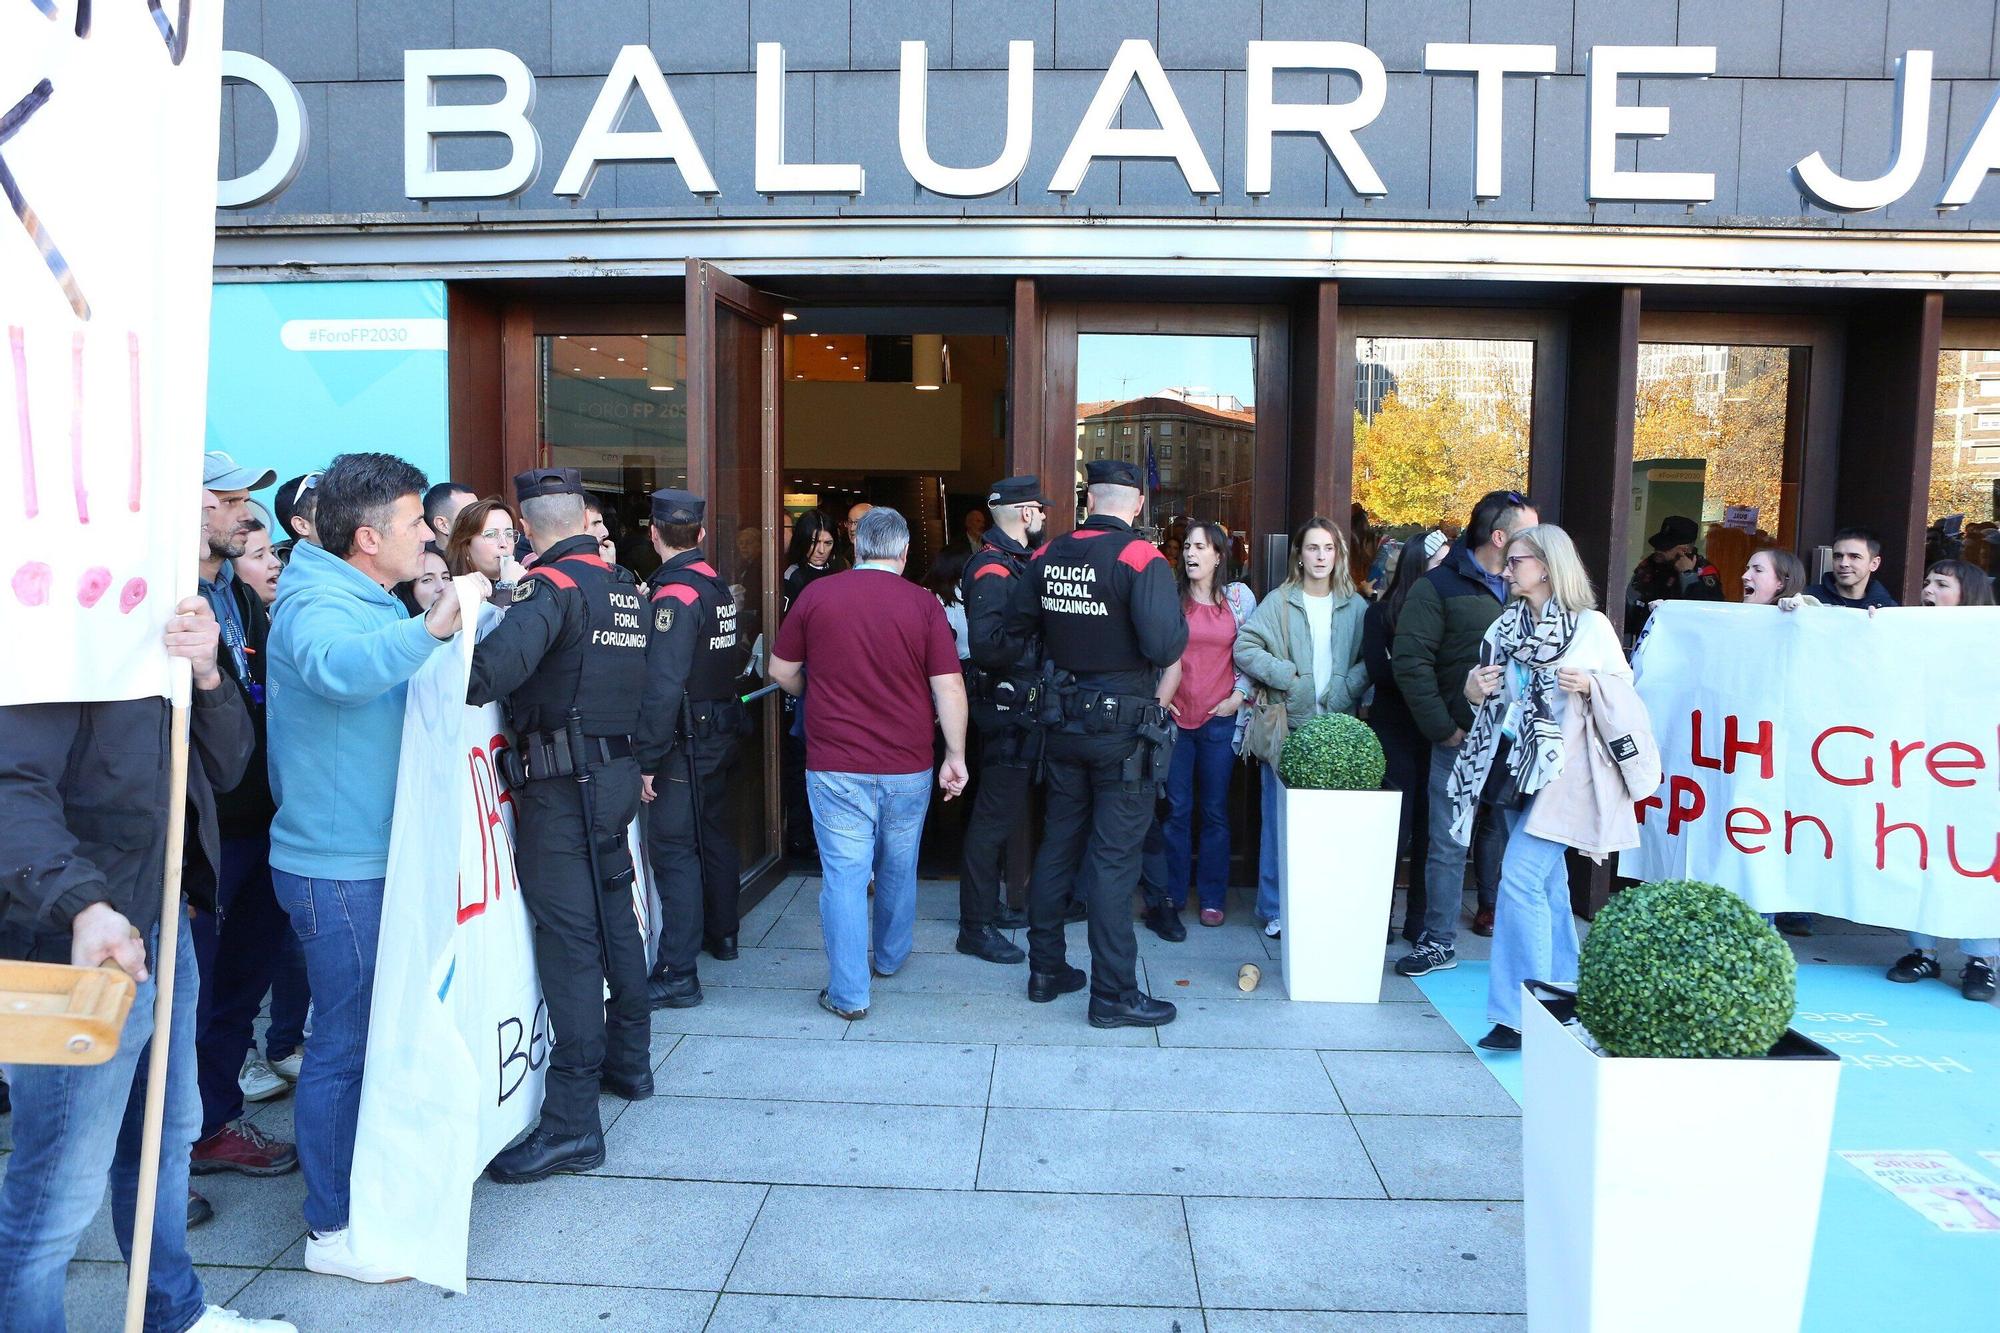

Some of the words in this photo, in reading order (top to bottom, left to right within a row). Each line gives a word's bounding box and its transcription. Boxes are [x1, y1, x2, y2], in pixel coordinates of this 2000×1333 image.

[404, 38, 1718, 203] BALUARTE
[308, 328, 408, 343] #ForoFP2030
[580, 401, 628, 418] FORO
[632, 403, 655, 418] FP
[1043, 563, 1096, 582] POLICÍA
[1046, 581, 1092, 598] FORAL
[1040, 595, 1108, 616] FORUZAINGOA
[614, 612, 640, 629] FORAL
[592, 629, 647, 648] FORUZAINGO
[1691, 709, 1774, 779] LH
[1811, 723, 2000, 789] Gre
[1725, 806, 1833, 860] en
[1841, 1055, 1973, 1073] Hast
